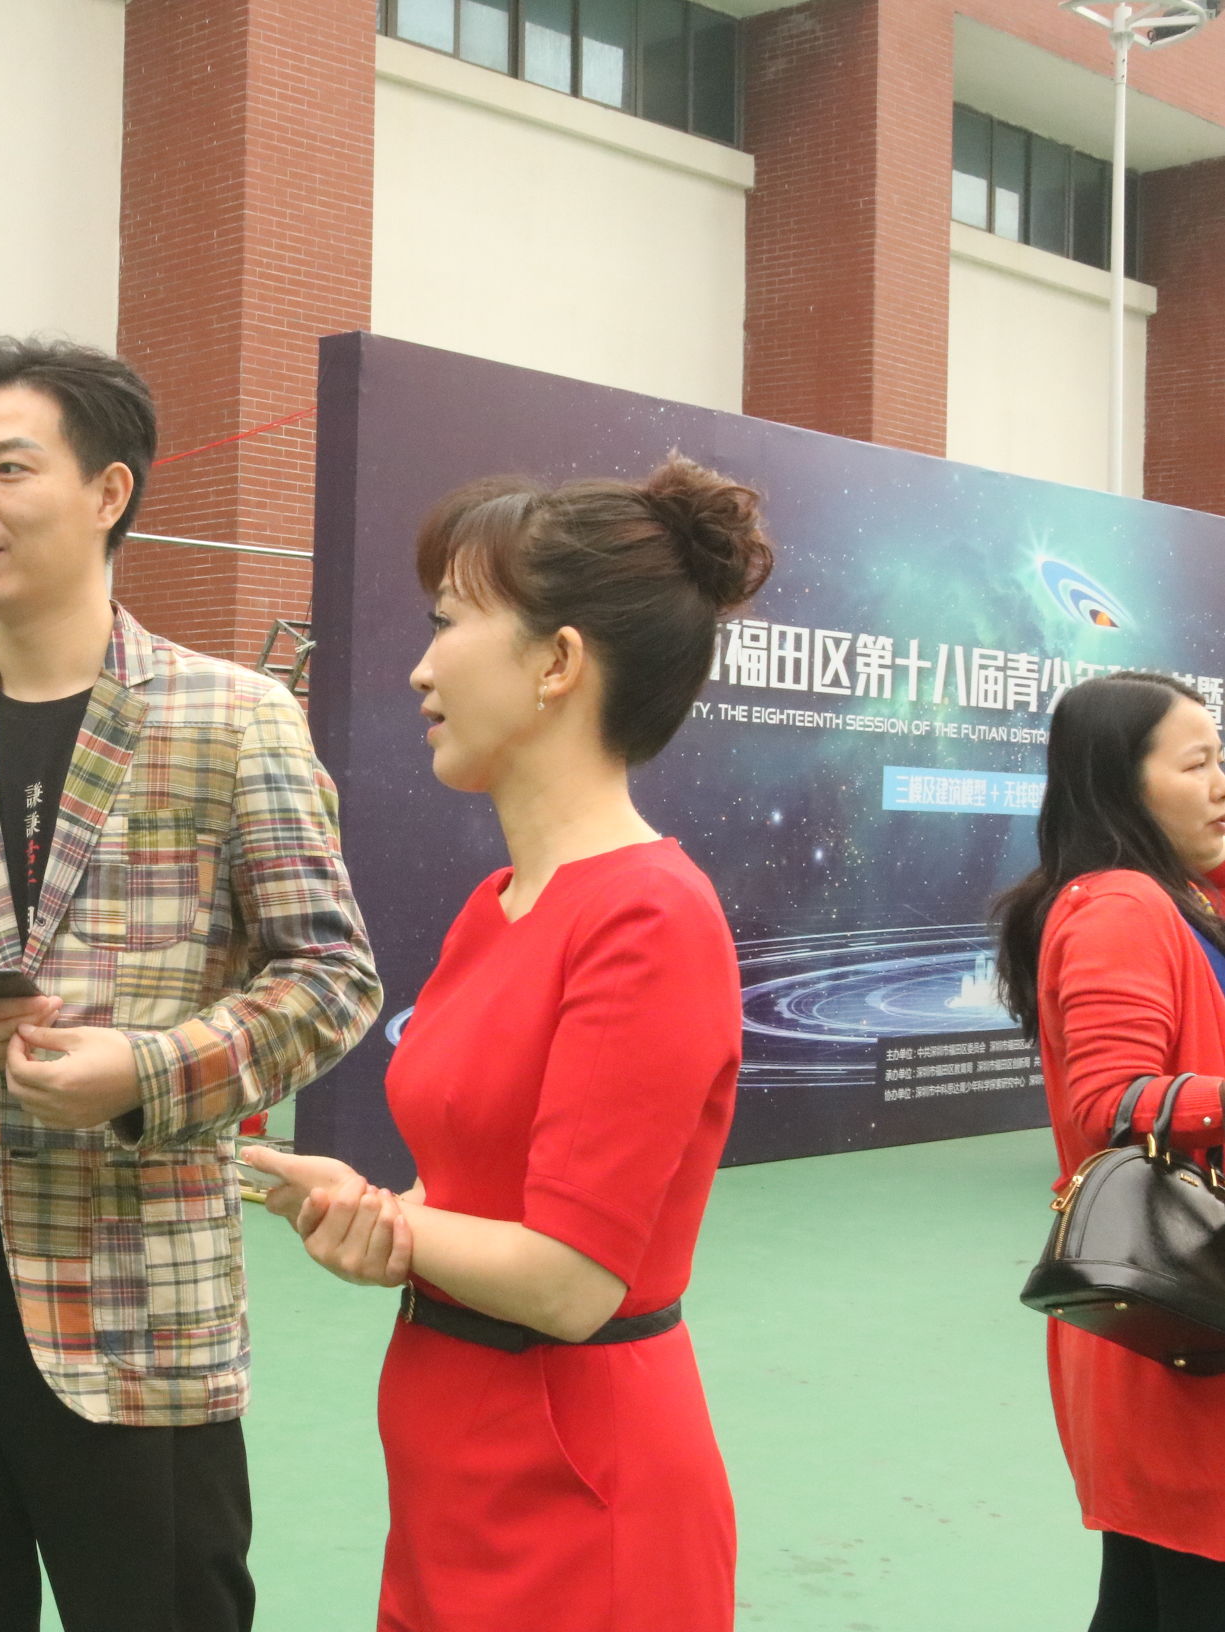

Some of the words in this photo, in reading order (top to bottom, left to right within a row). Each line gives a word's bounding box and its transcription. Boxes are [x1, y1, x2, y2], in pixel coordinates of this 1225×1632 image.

[717, 703, 748, 723] THE
[752, 706, 842, 730] EIGHTEENTH
[845, 715, 908, 735] SESSION
[912, 719, 930, 735] OF
[934, 723, 959, 738] THE
[960, 724, 1007, 742] FUTIAN
